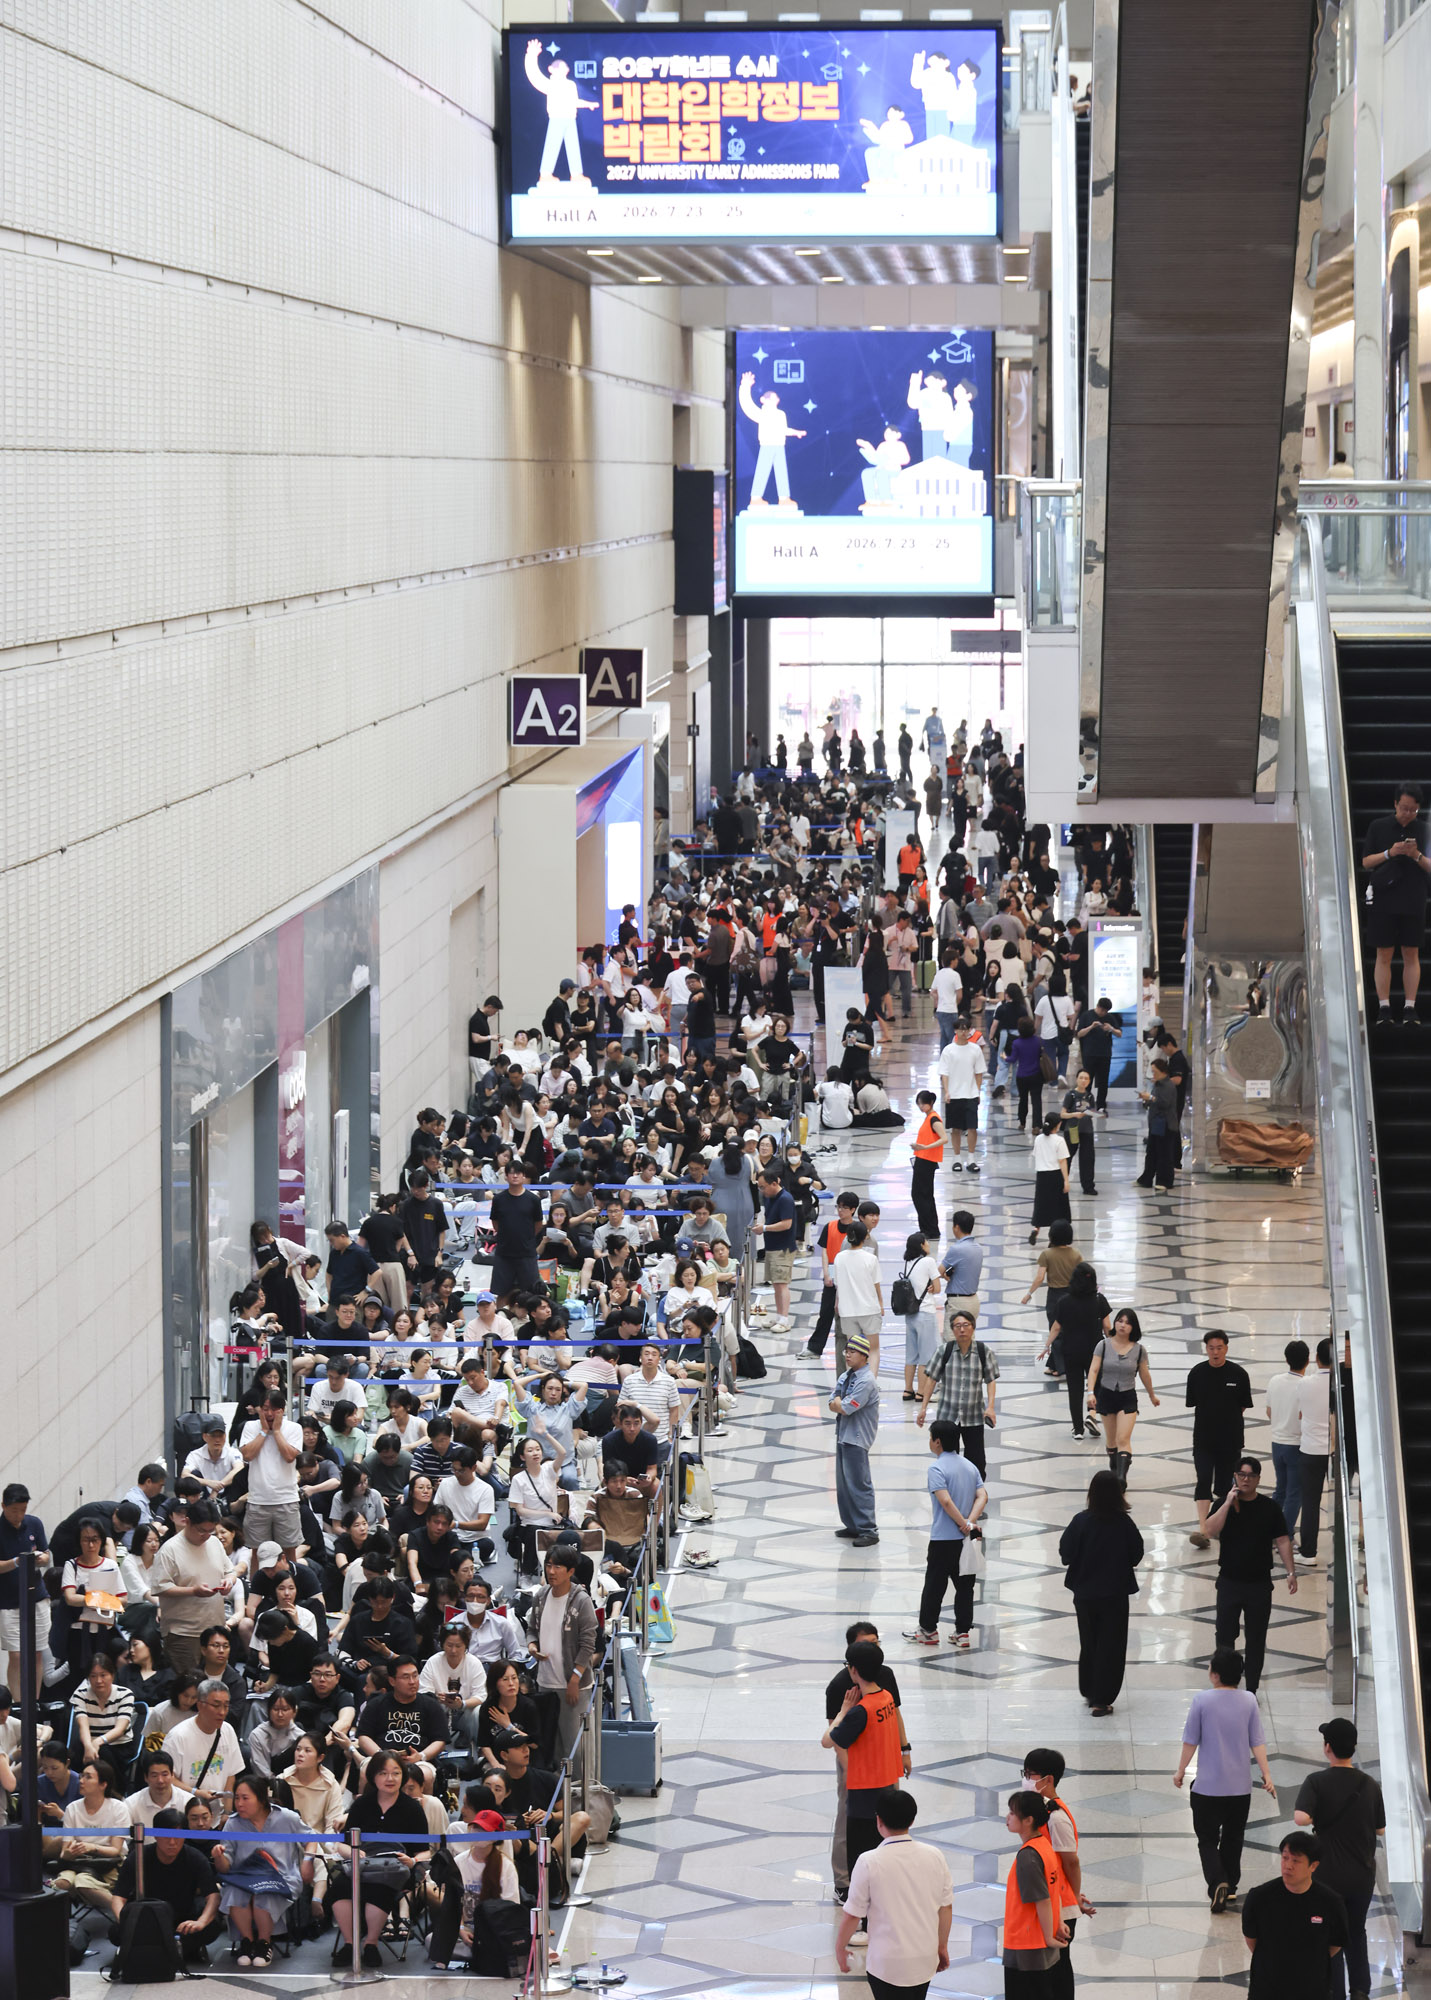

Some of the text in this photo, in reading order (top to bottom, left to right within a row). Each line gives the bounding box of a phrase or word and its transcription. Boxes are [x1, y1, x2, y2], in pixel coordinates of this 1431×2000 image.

[602, 55, 777, 78] 2027학년도 수시
[602, 80, 840, 122] 대학입학정보
[603, 121, 721, 163] 박람회
[607, 164, 840, 180] 2027 UNIVERSITY EARLY ADMISSIONS FAIR
[547, 209, 598, 222] Hall A
[773, 545, 819, 558] Hall A
[516, 687, 578, 736] A2
[388, 1710, 421, 1721] LOEWE
[876, 1702, 896, 1723] STAF
